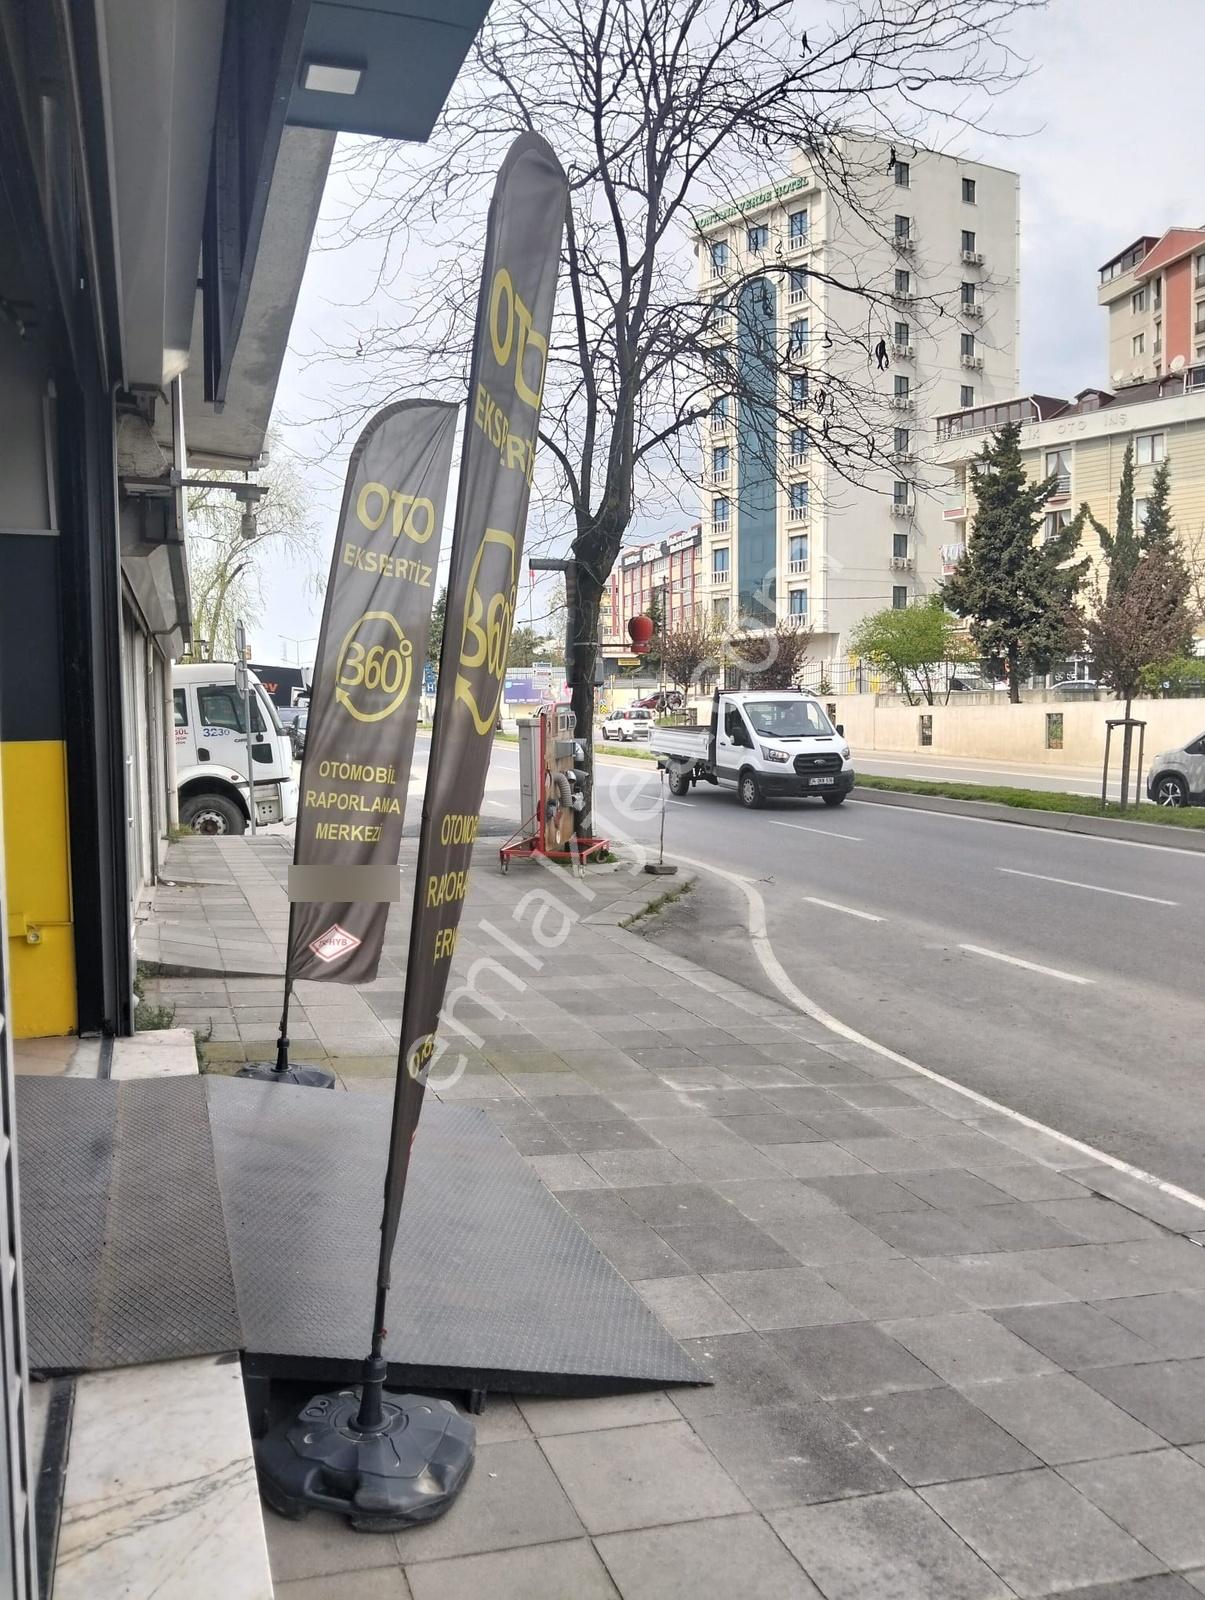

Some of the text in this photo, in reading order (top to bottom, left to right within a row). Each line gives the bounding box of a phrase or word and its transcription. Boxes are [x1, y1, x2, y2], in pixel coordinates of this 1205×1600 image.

[357, 482, 435, 544] OTO
[319, 760, 396, 785] OTOMOBİL
[305, 790, 400, 815] RAPORLAMA
[315, 822, 385, 842] MERKEZİ
